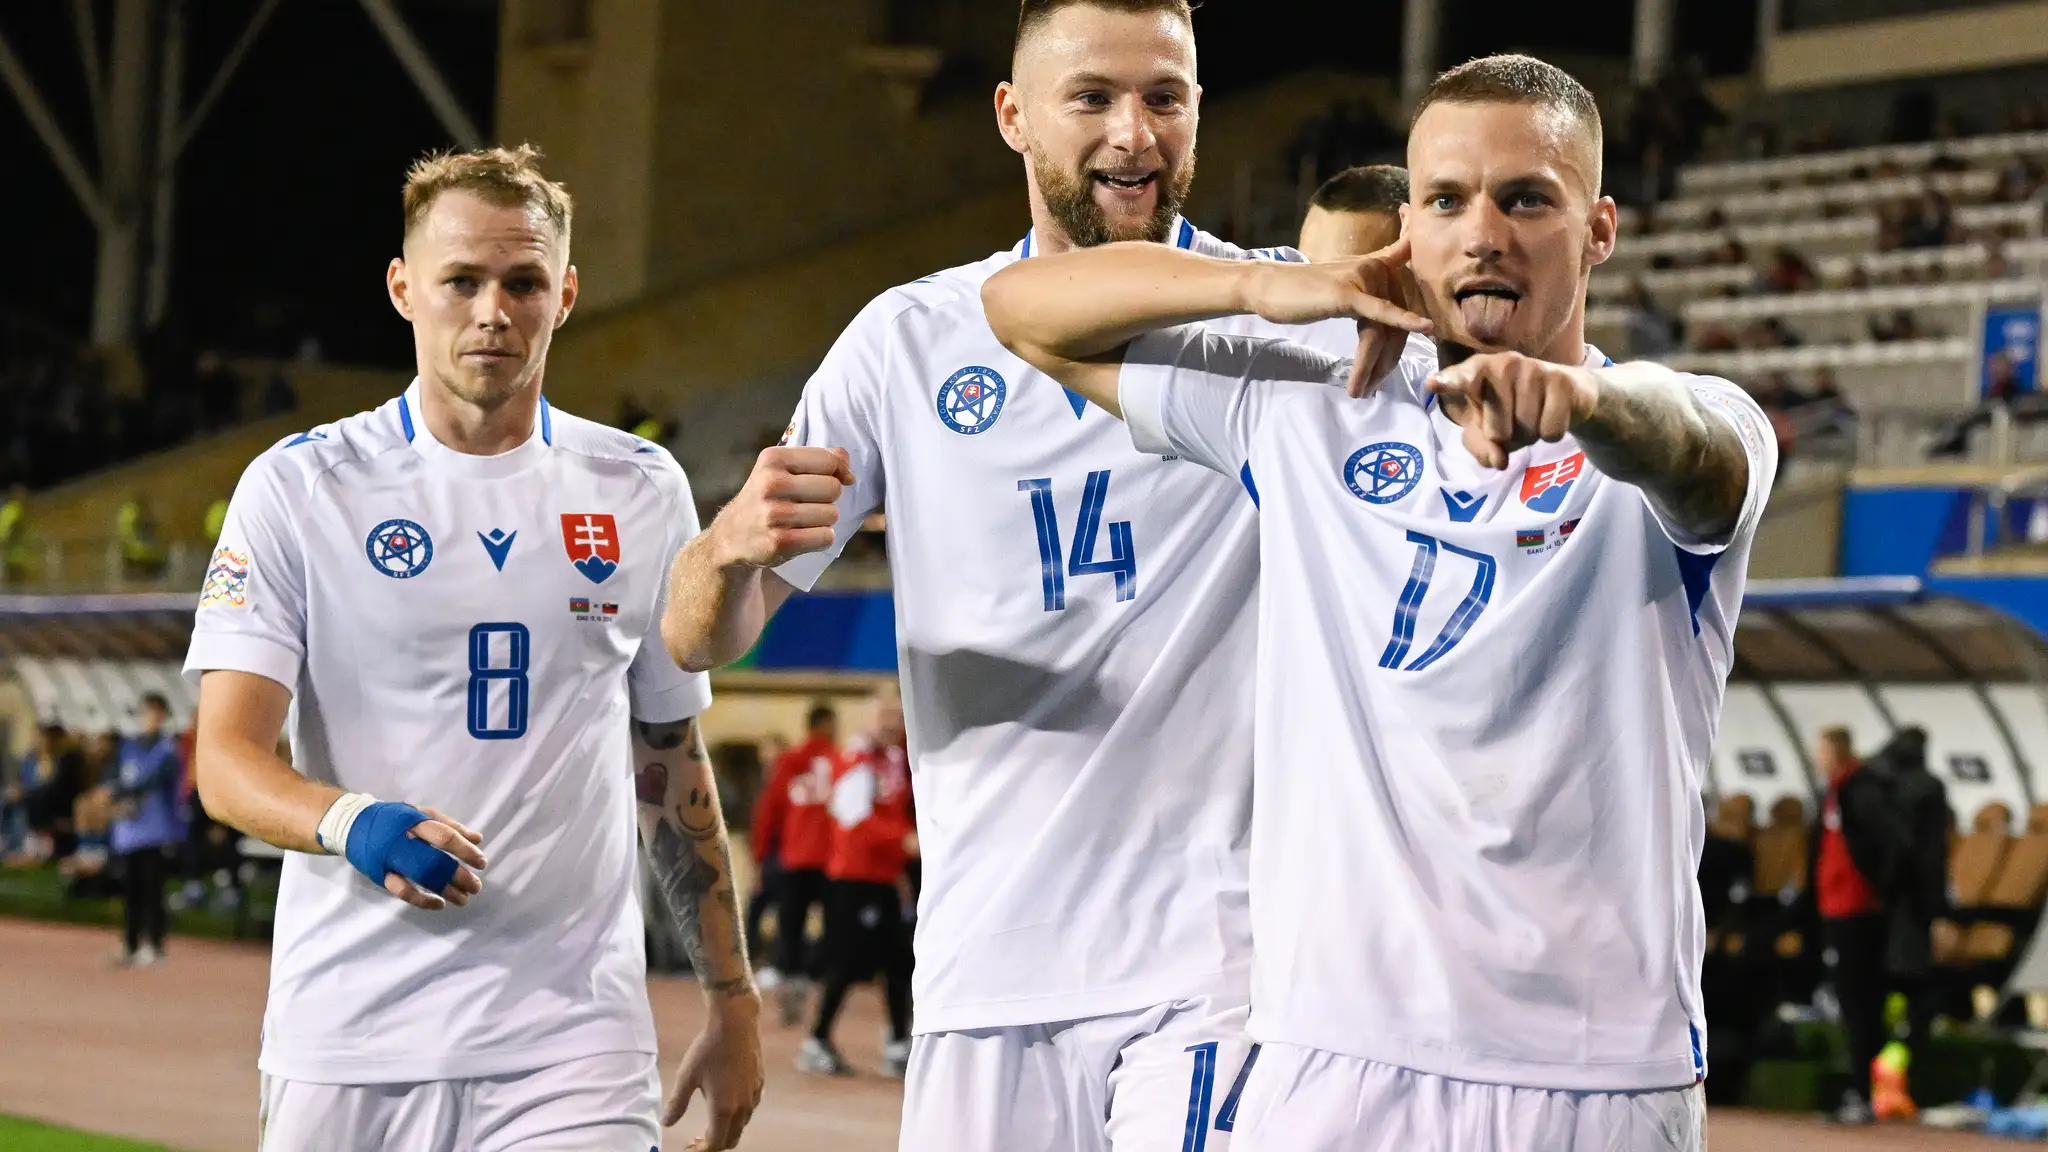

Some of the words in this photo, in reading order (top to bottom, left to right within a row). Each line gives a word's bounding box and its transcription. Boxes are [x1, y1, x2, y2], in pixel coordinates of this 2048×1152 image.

[959, 426, 980, 434] SFZ
[1018, 469, 1137, 612] 14
[1349, 482, 1367, 499] SFZ
[1377, 528, 1497, 672] 17
[467, 622, 530, 740] 8
